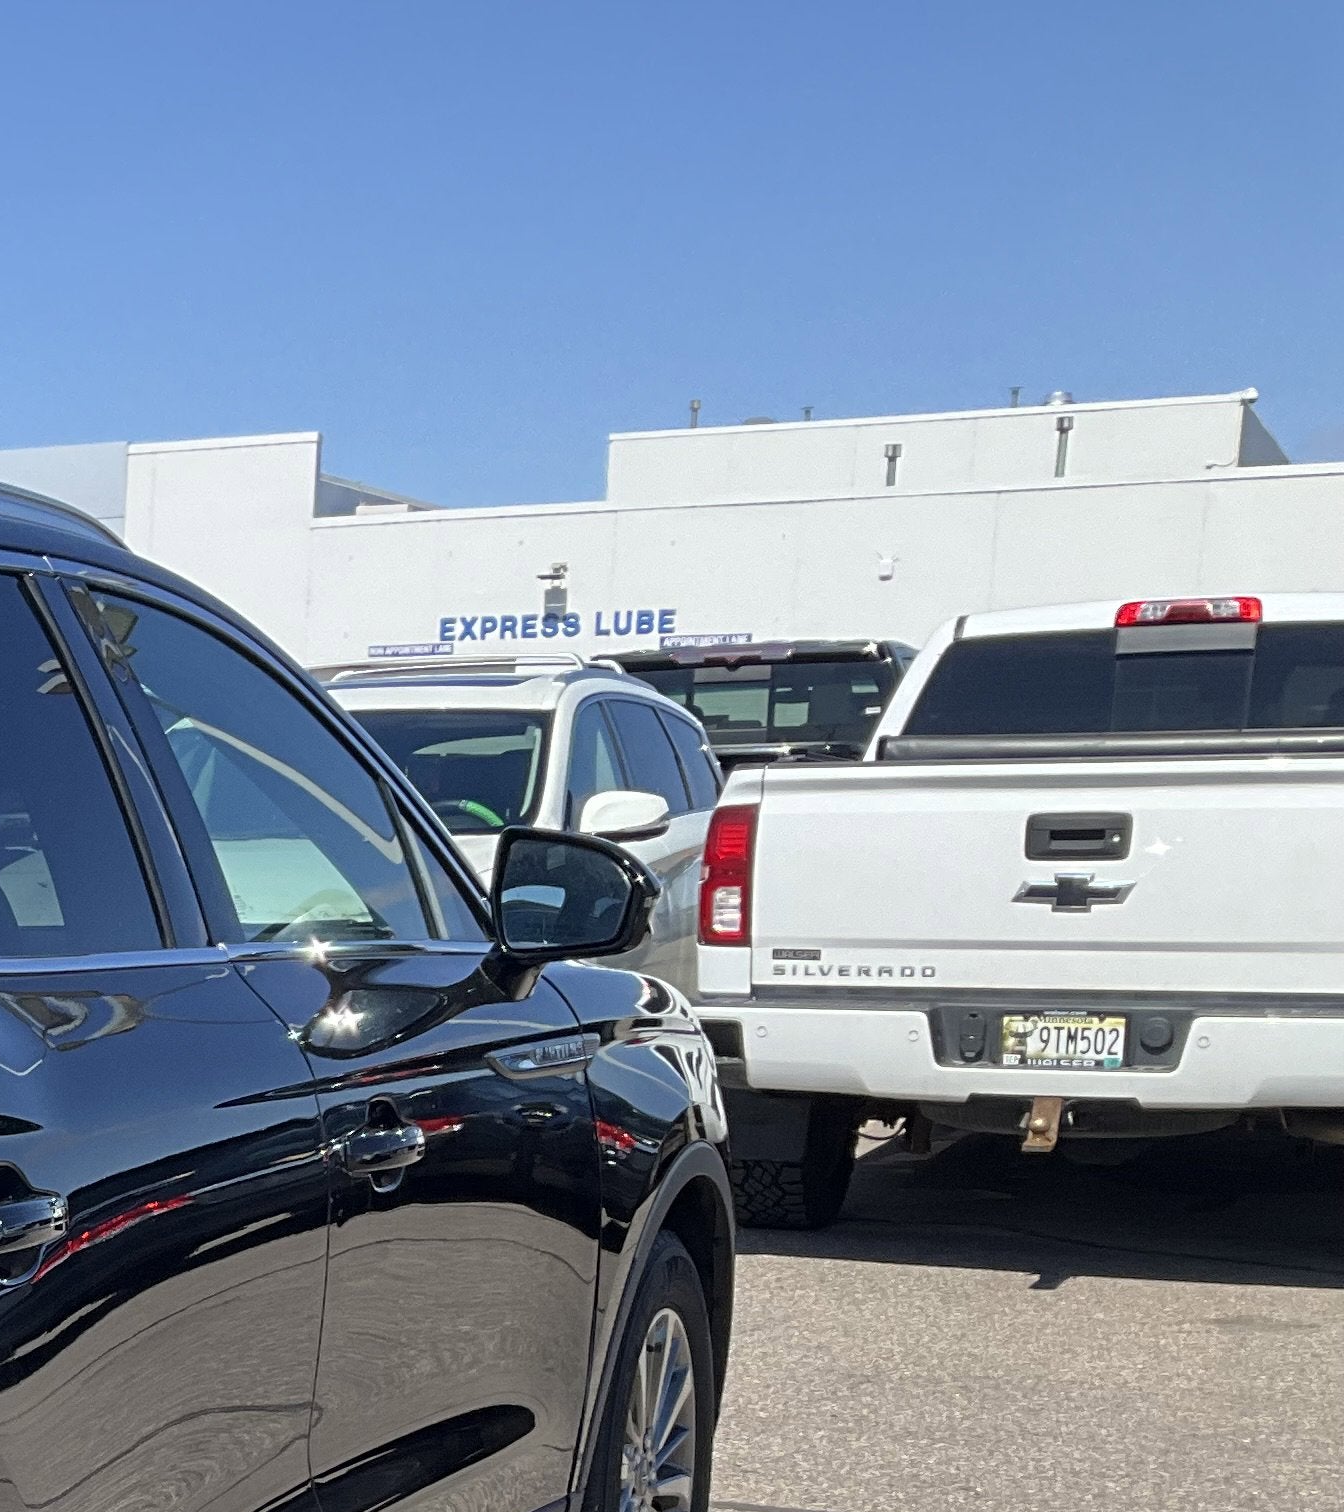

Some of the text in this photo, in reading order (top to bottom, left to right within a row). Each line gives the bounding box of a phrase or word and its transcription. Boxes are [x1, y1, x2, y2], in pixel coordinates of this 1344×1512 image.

[439, 608, 678, 642] EXPRESS LUBE
[773, 965, 936, 978] SILVERADO
[1039, 1026, 1120, 1056] 9TM502
